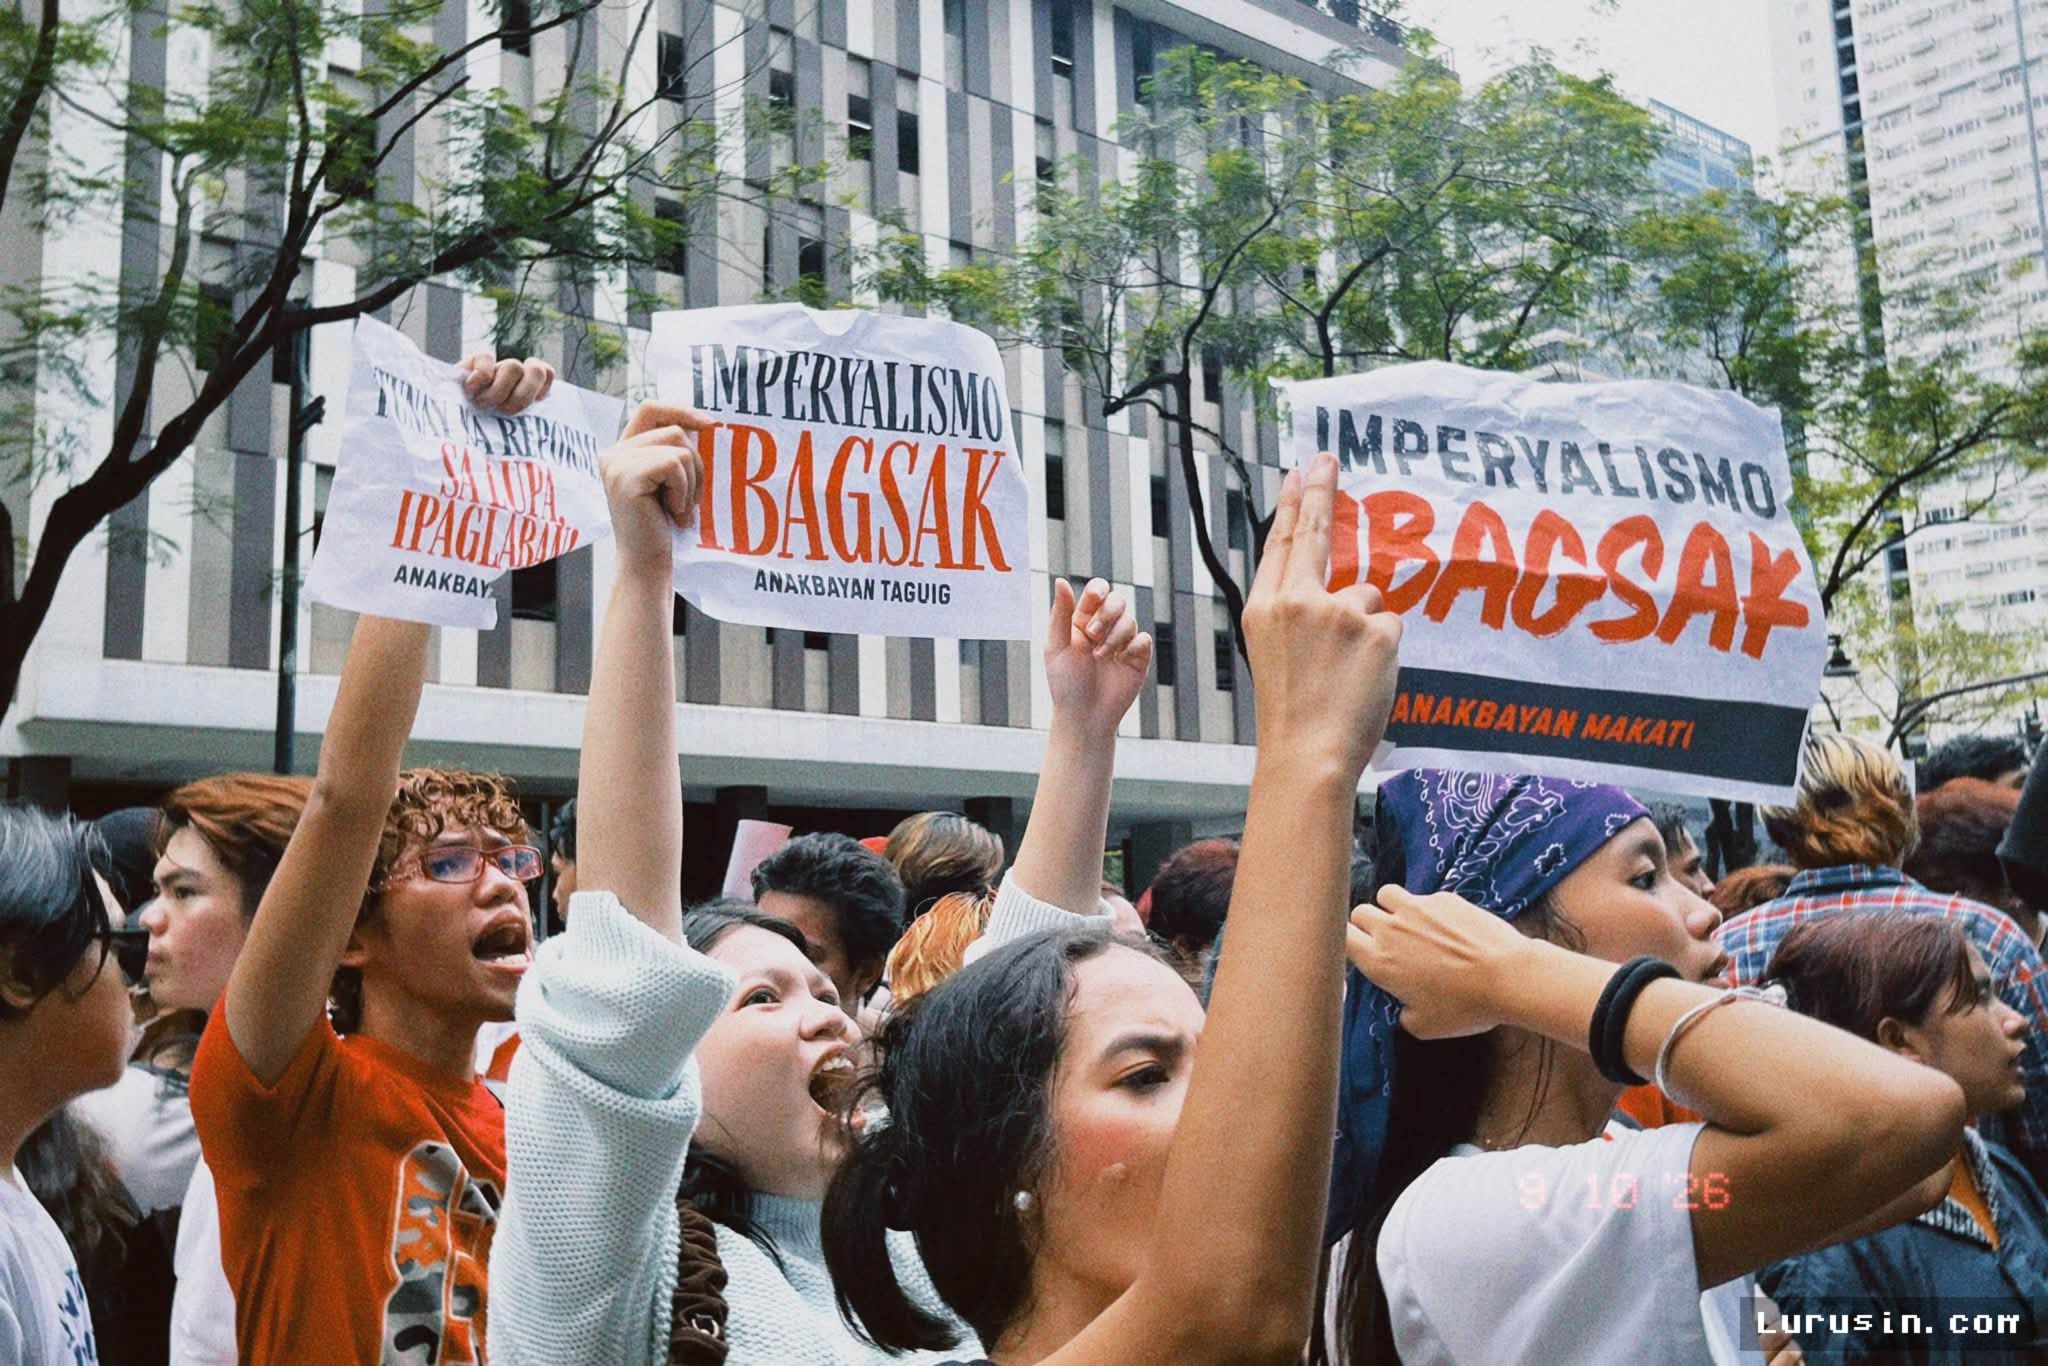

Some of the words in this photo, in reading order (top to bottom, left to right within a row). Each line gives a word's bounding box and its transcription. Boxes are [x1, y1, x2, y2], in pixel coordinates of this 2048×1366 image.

[691, 343, 1003, 442] IMPERYALISMO
[440, 442, 479, 504] SA
[696, 421, 1012, 572] IBAGSAK
[1316, 406, 1776, 518] IMPERYALISMO
[754, 569, 875, 601] ANAKBAYAN
[880, 579, 951, 605] TAGUIG
[1326, 489, 1809, 660] IBAGSAK
[1391, 692, 1579, 740] ANAKBAYAN
[1581, 714, 1694, 750] MAKATI
